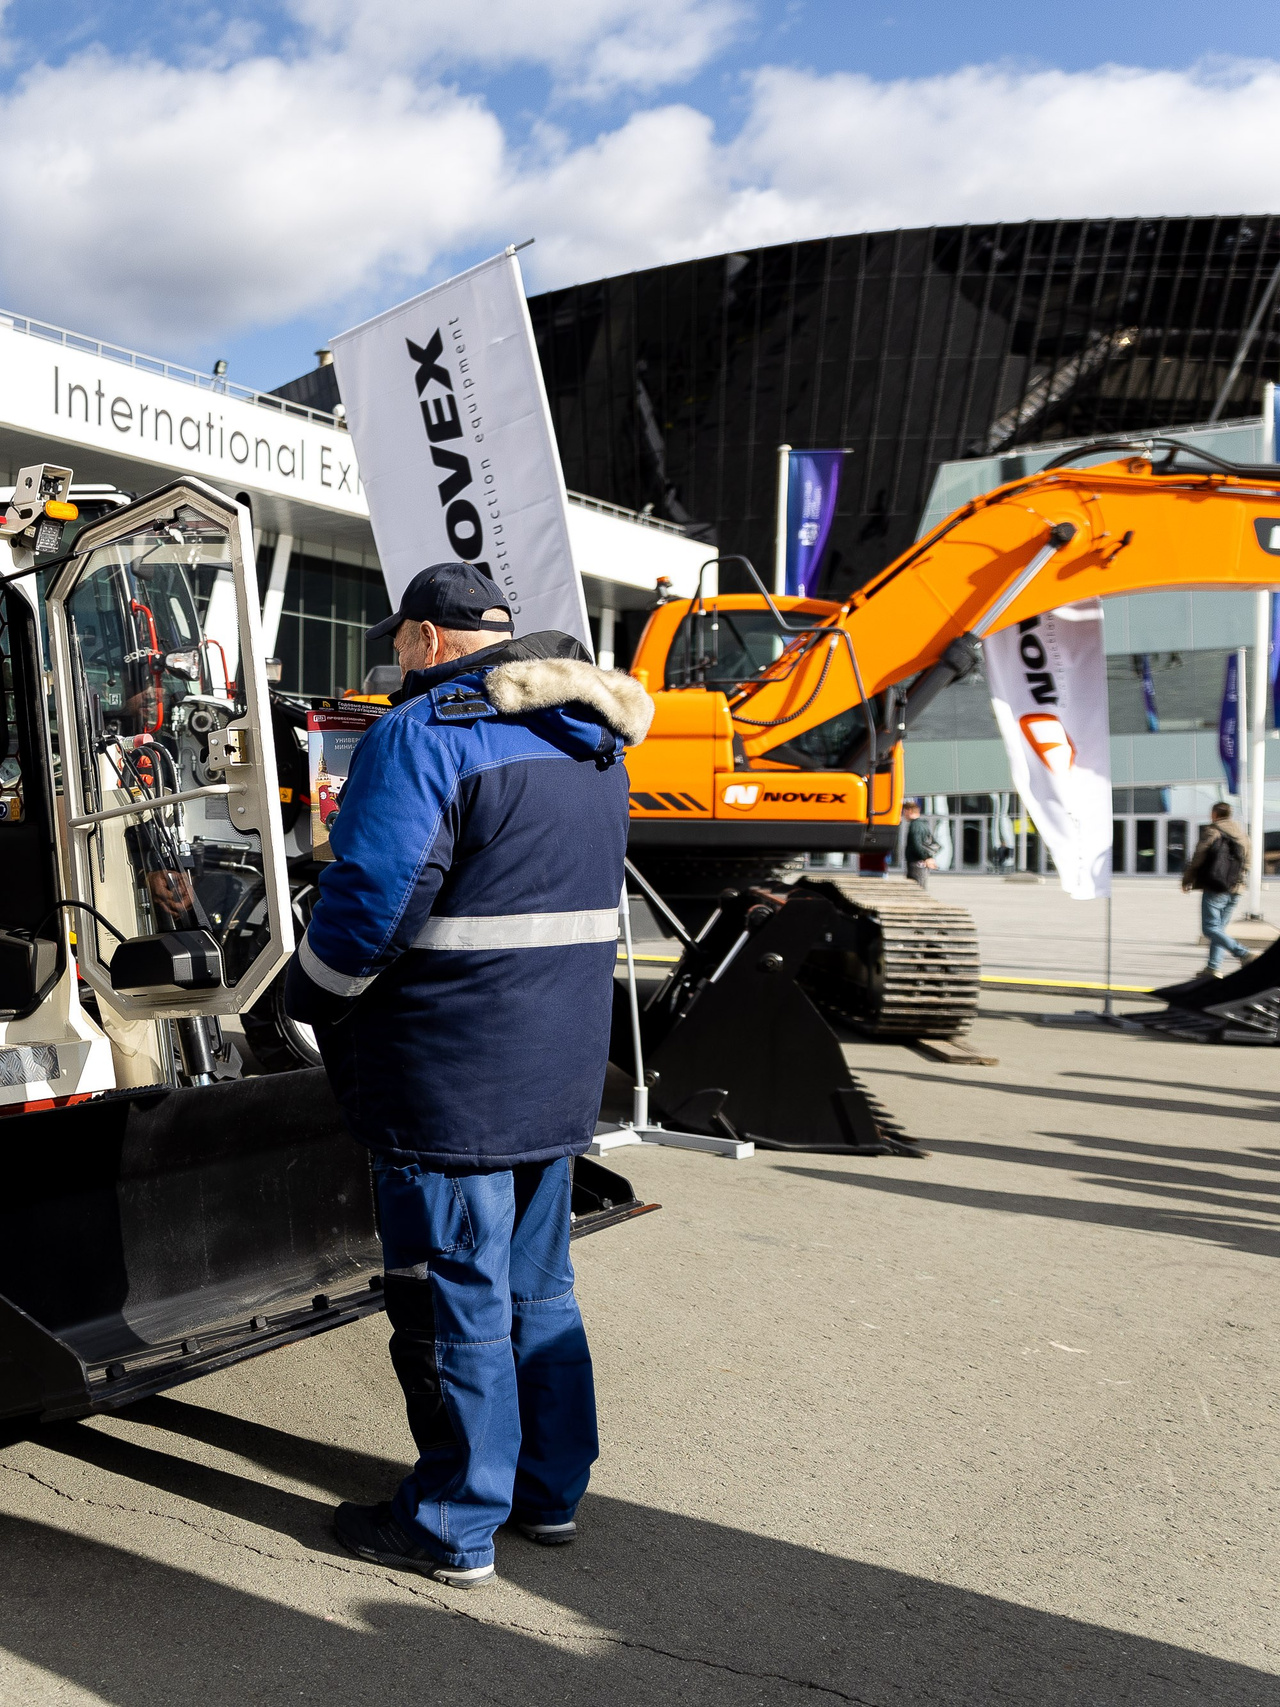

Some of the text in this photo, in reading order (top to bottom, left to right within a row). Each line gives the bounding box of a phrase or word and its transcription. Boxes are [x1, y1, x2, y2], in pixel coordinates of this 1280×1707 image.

[54, 366, 305, 481] International
[447, 317, 521, 615] construction equipment
[763, 792, 847, 803] NOVEX
